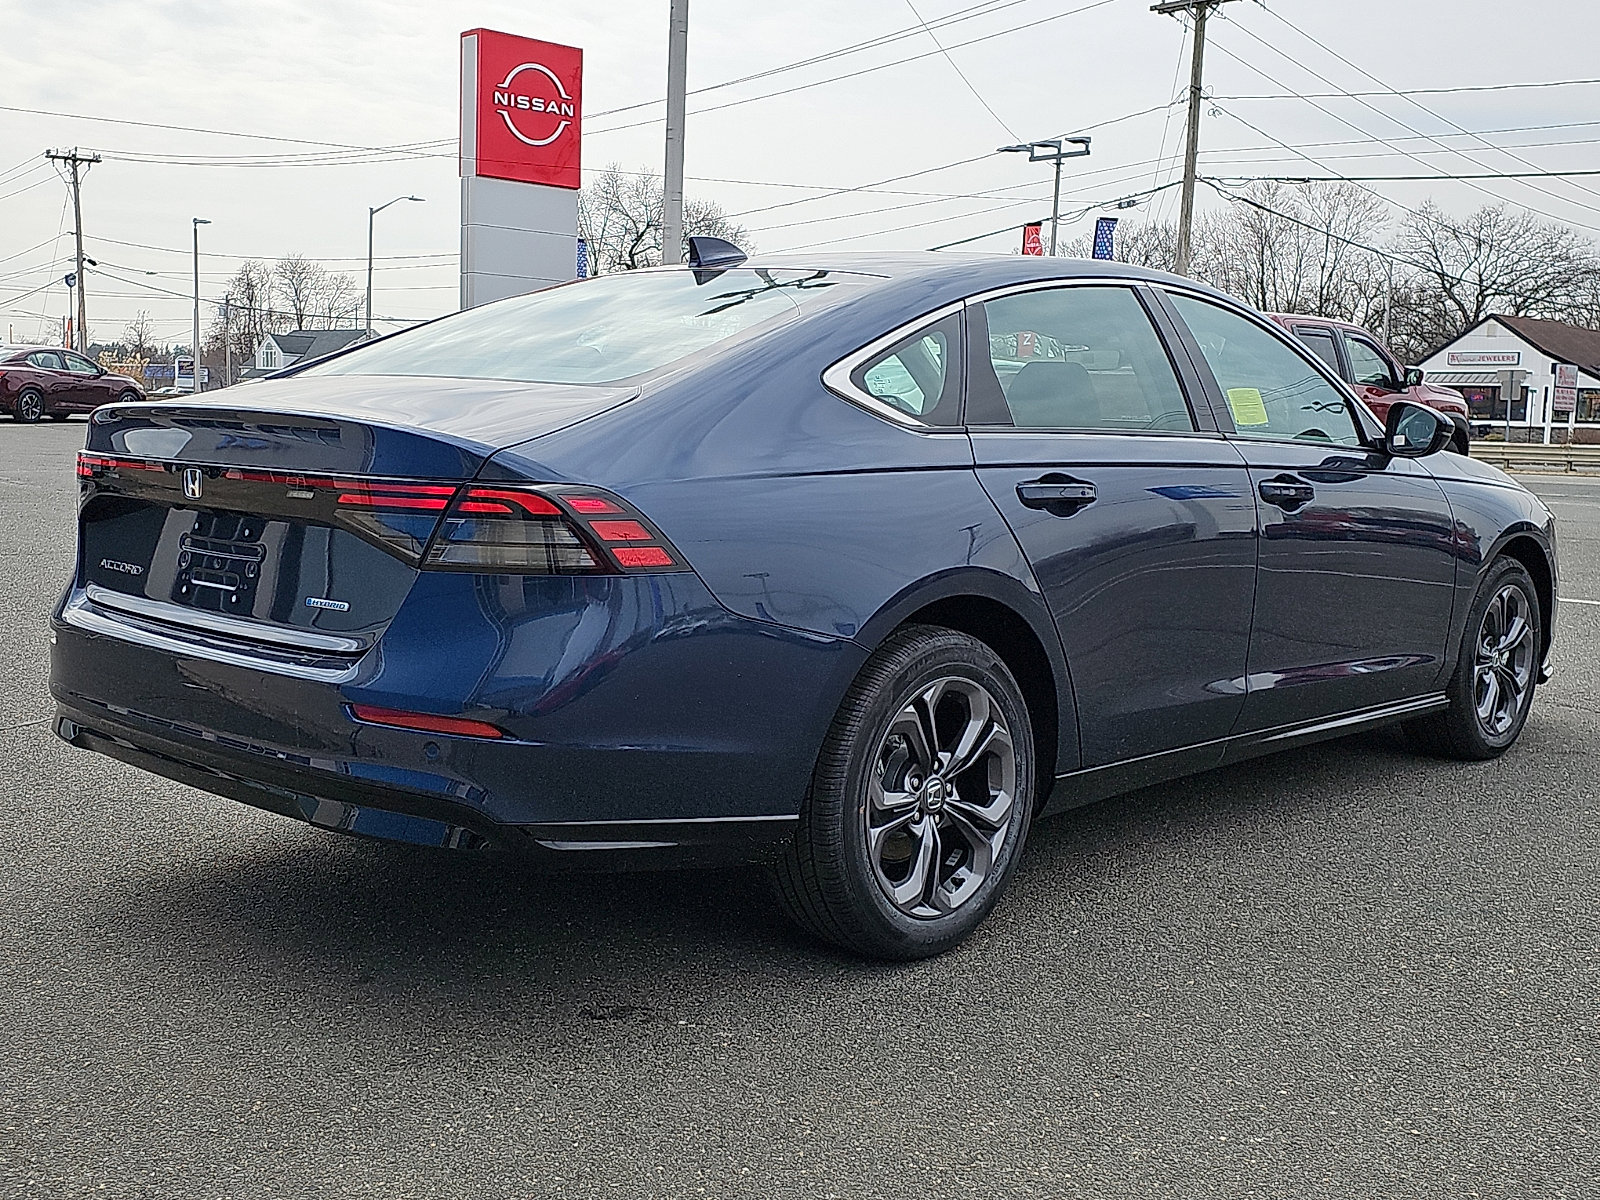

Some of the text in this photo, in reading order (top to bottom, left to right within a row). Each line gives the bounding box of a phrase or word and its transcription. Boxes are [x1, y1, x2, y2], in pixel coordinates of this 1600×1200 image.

[494, 91, 574, 117] NISSAN
[1478, 354, 1516, 362] JEWELERS
[99, 558, 144, 575] ACCORD
[312, 599, 346, 610] HYBRID
